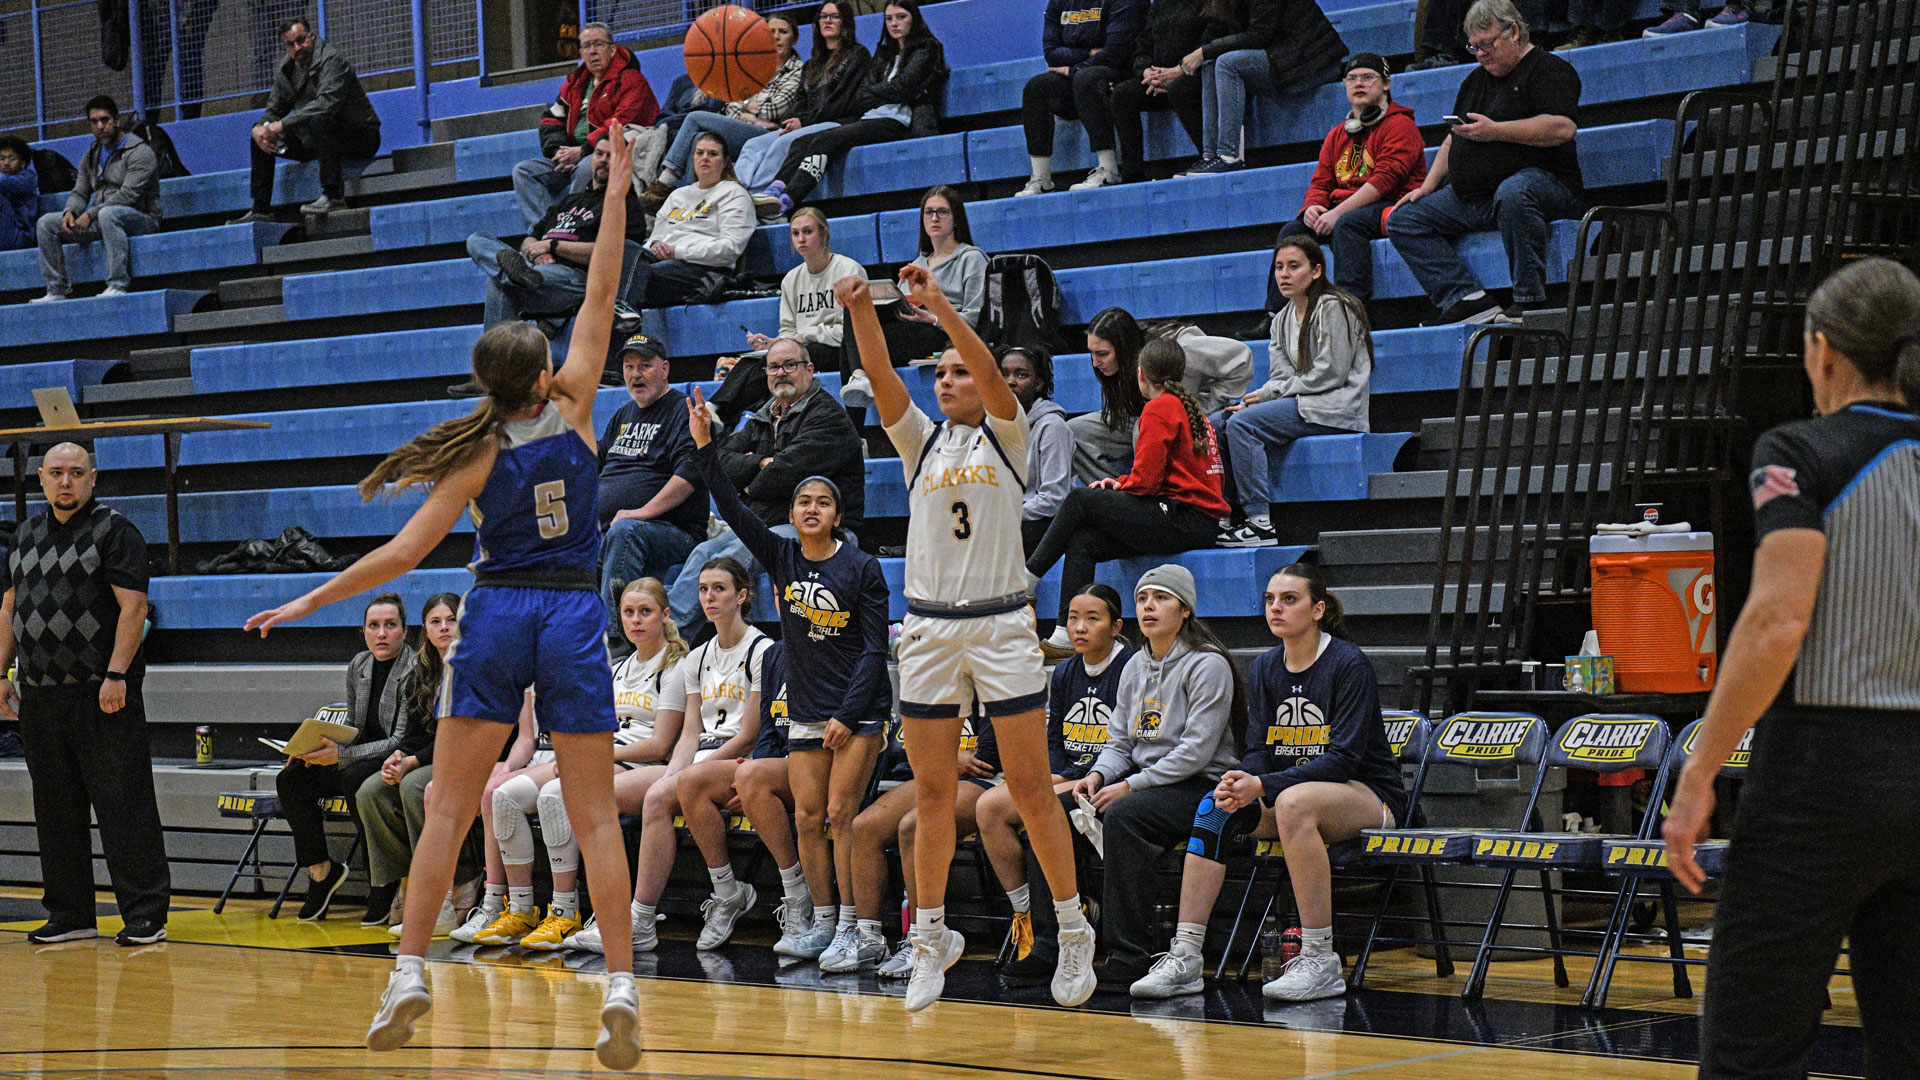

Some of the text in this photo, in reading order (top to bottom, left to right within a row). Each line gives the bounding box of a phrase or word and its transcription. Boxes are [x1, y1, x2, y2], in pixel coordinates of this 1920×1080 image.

[922, 464, 1000, 497] CLARKE
[534, 479, 570, 540] 5
[950, 498, 974, 542] 3
[1693, 573, 1714, 615] G
[614, 690, 654, 712] ARKE
[702, 682, 748, 703] LARKE
[315, 709, 348, 726] CLAR
[1062, 721, 1111, 744] PRID
[1265, 724, 1332, 746] PRIDE
[1442, 719, 1532, 746] CLARKE
[1564, 722, 1651, 748] CLARKE
[1274, 745, 1325, 756] BASKETBALL
[1465, 744, 1505, 755] PRIDE
[1586, 748, 1627, 757] PRIDE
[217, 795, 256, 812] PRIDE
[1365, 835, 1449, 855] PRIDE
[1475, 838, 1560, 859] PRIDE
